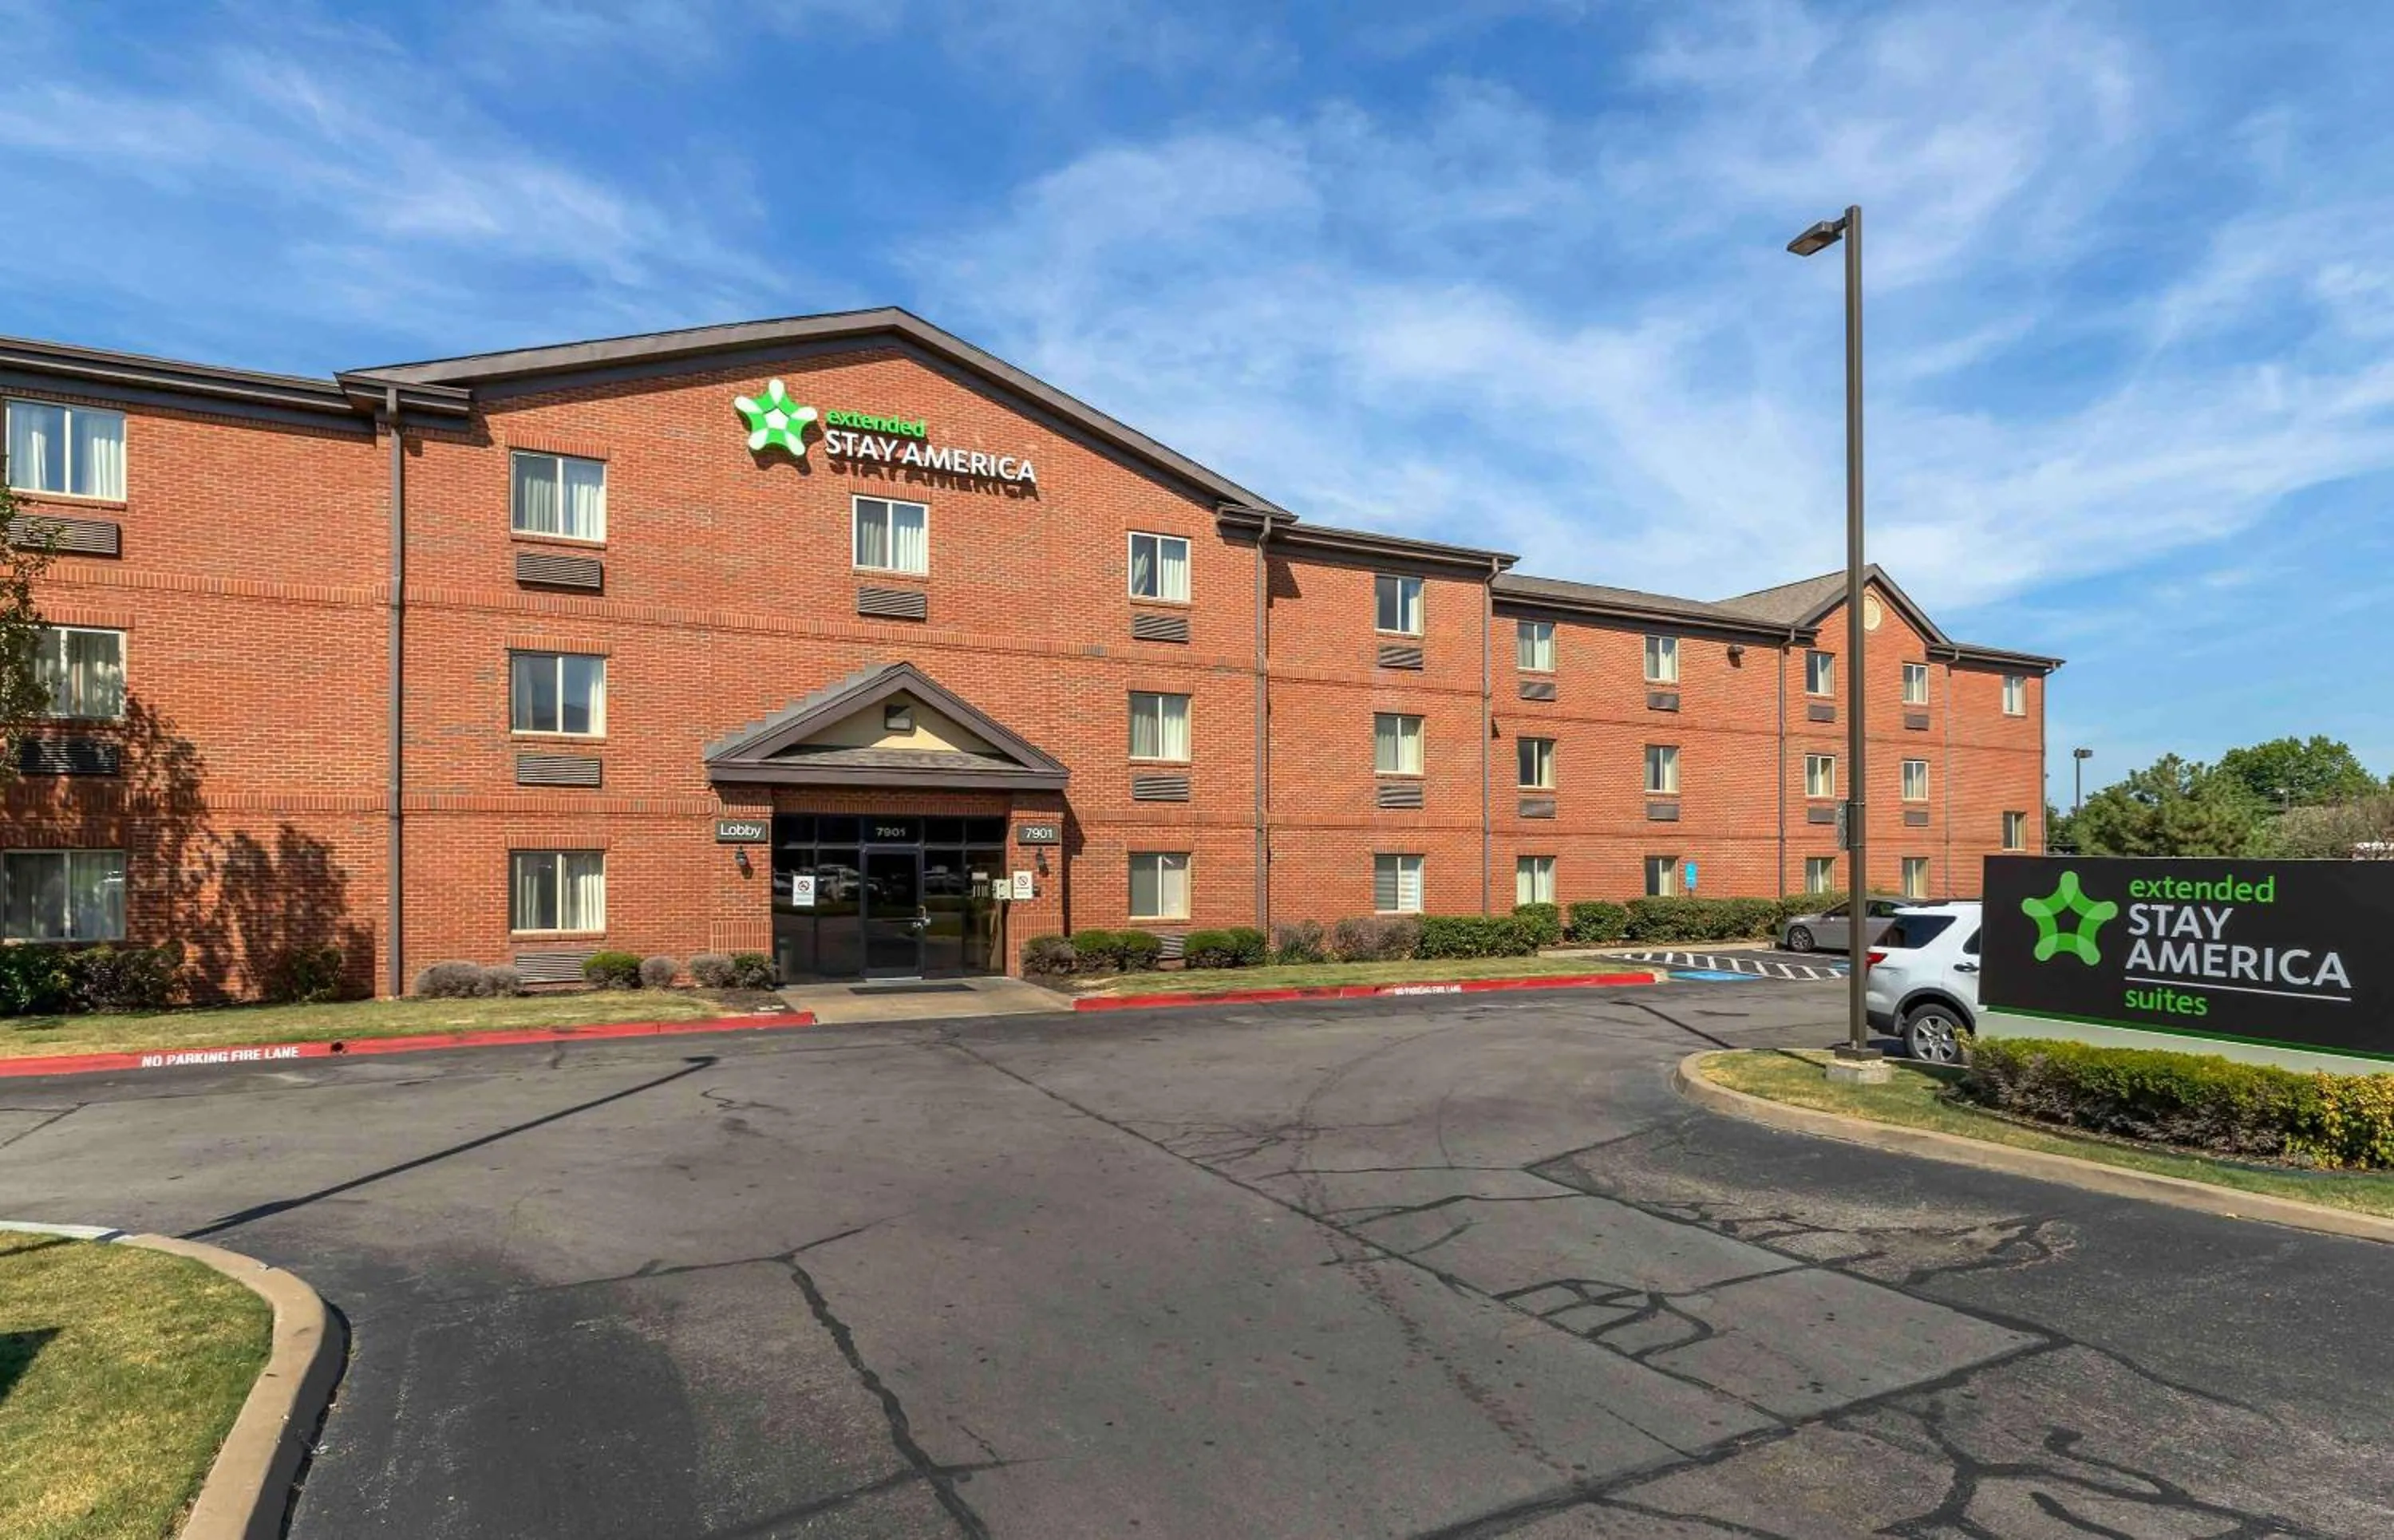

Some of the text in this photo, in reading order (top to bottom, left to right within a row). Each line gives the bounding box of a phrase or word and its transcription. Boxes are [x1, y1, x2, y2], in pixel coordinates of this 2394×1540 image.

[826, 409, 926, 437] extended
[825, 429, 1037, 483] STAY AMERICA
[721, 823, 761, 838] Lobby
[876, 827, 907, 837] 7901
[1025, 827, 1053, 839] 7901
[2129, 875, 2274, 903] extended
[2127, 902, 2234, 940] STAY
[2125, 938, 2353, 989] AMERICA
[2125, 987, 2208, 1017] suites
[142, 1046, 299, 1067] NO PARKING FIRE LANE
